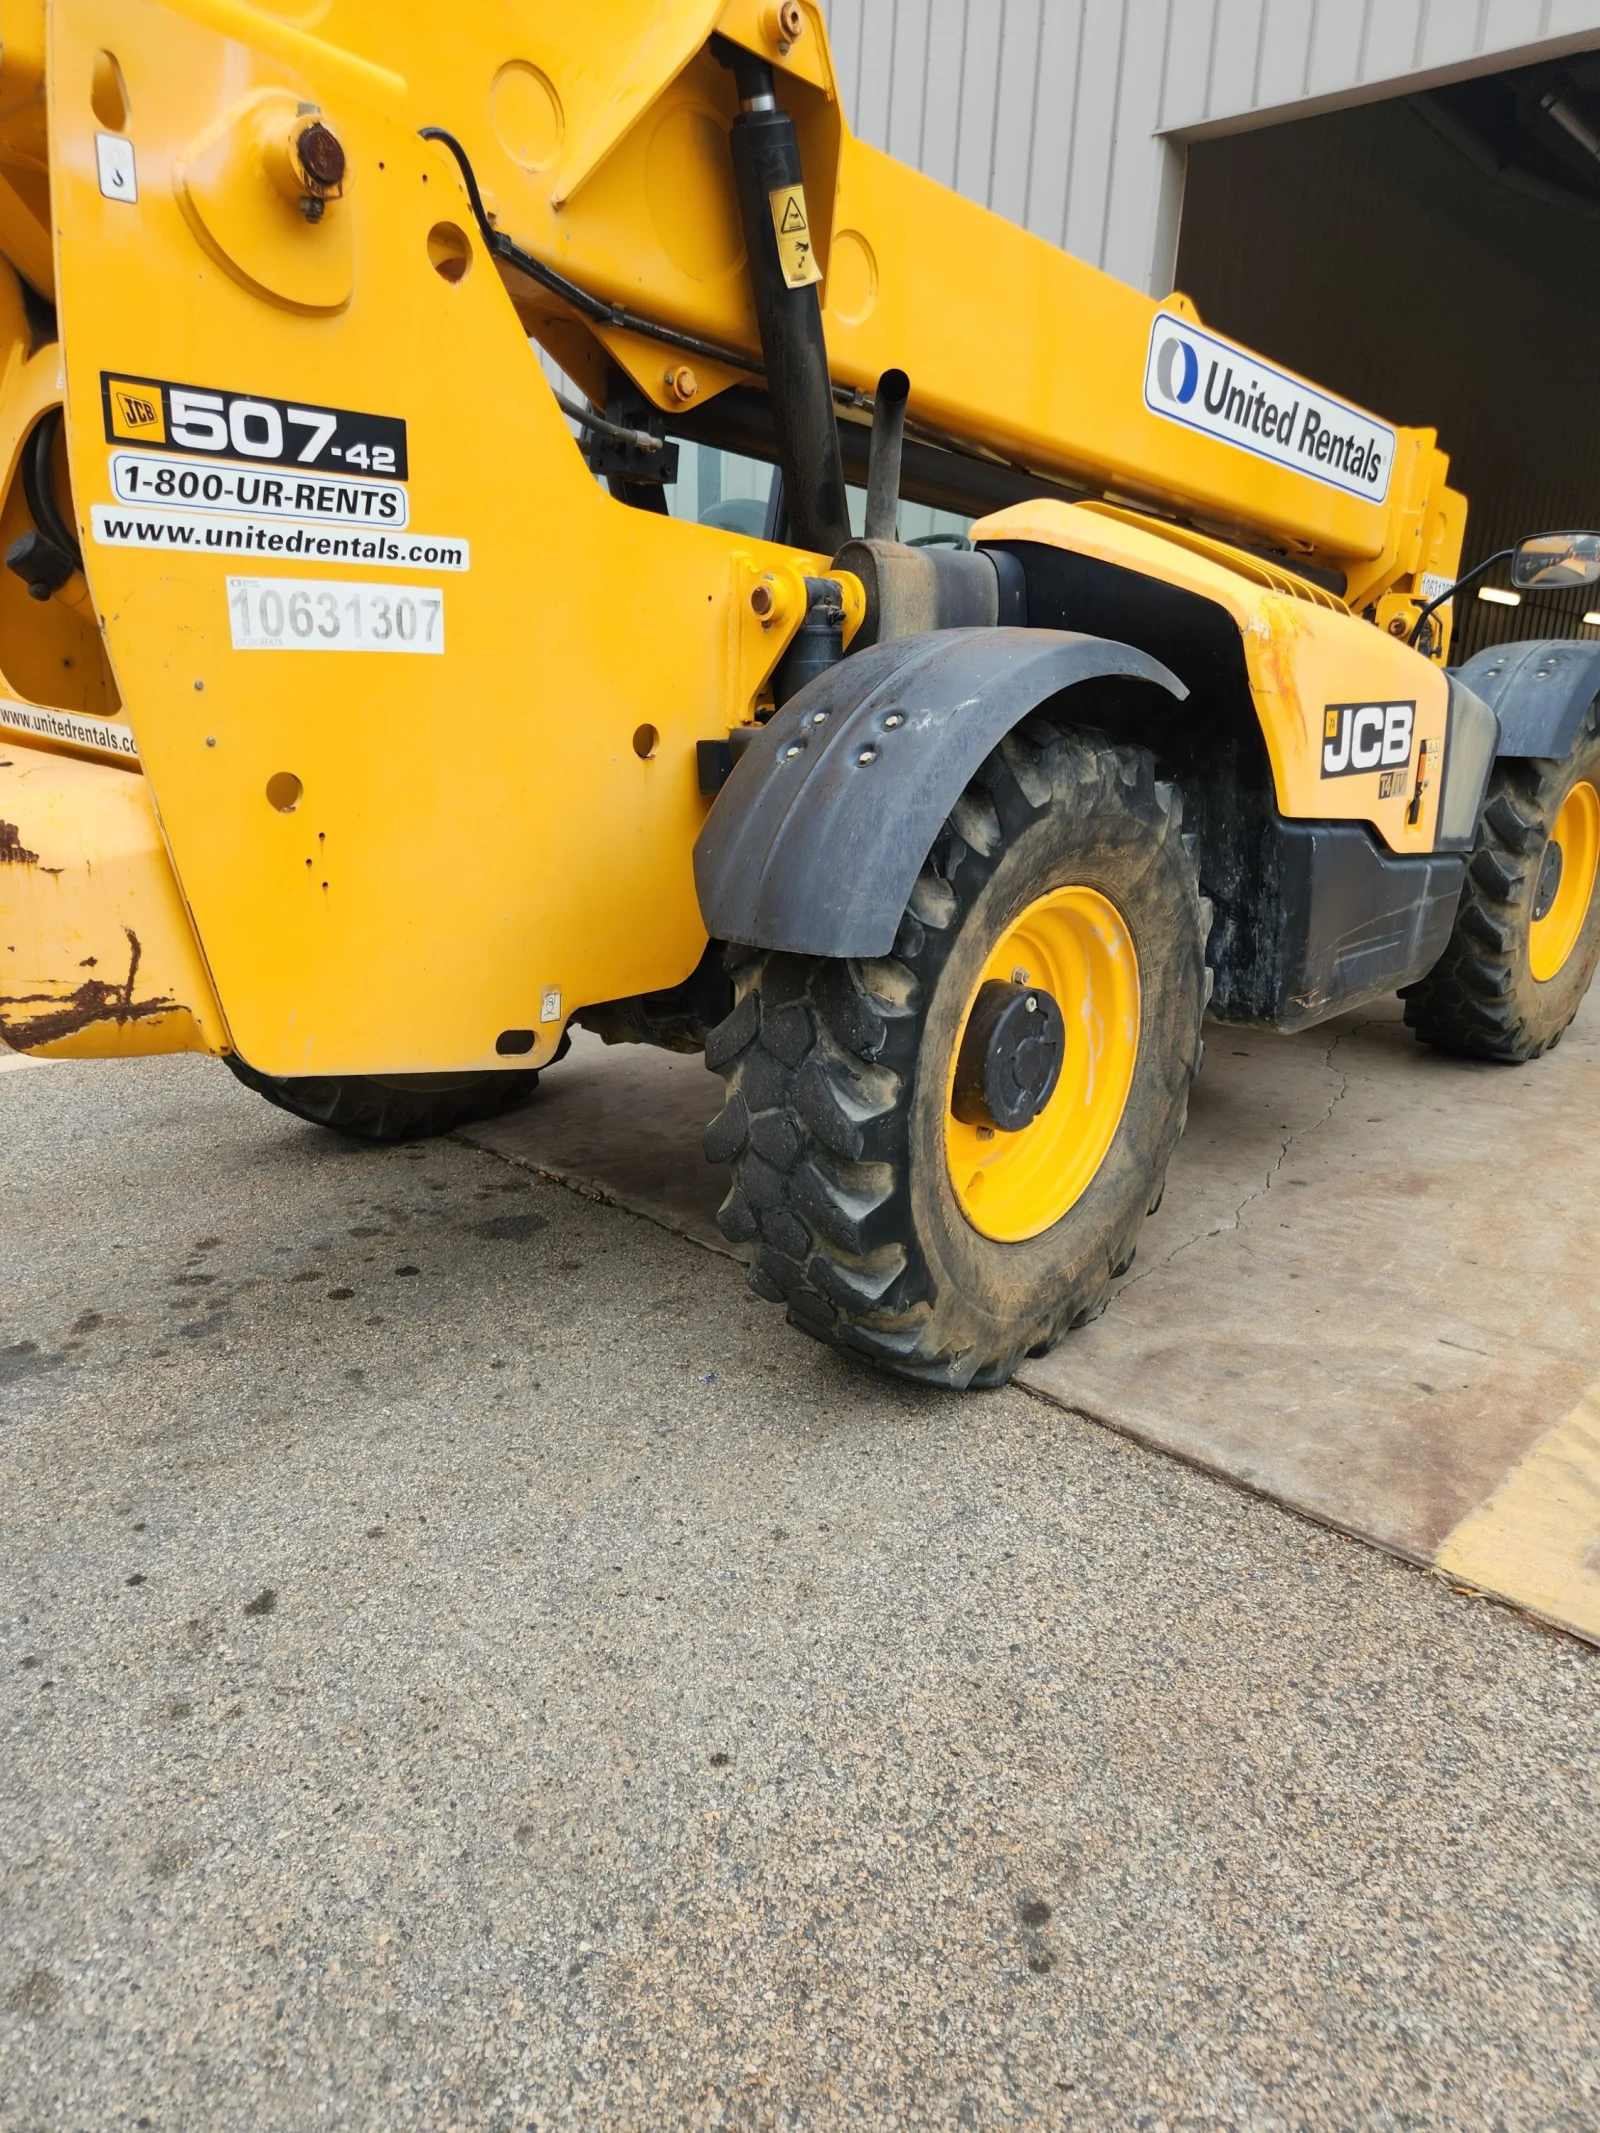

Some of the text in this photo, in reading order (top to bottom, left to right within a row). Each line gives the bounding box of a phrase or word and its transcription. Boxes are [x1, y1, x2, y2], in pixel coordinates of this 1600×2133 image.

[124, 397, 155, 424] JCB
[169, 386, 396, 473] 507-42
[1203, 360, 1382, 484] United Rentals
[124, 465, 397, 519] 1-800-UR-RENTS
[104, 518, 462, 566] www.unitedrentals.com
[230, 588, 441, 643] 10631307
[1323, 705, 1413, 773] JCB
